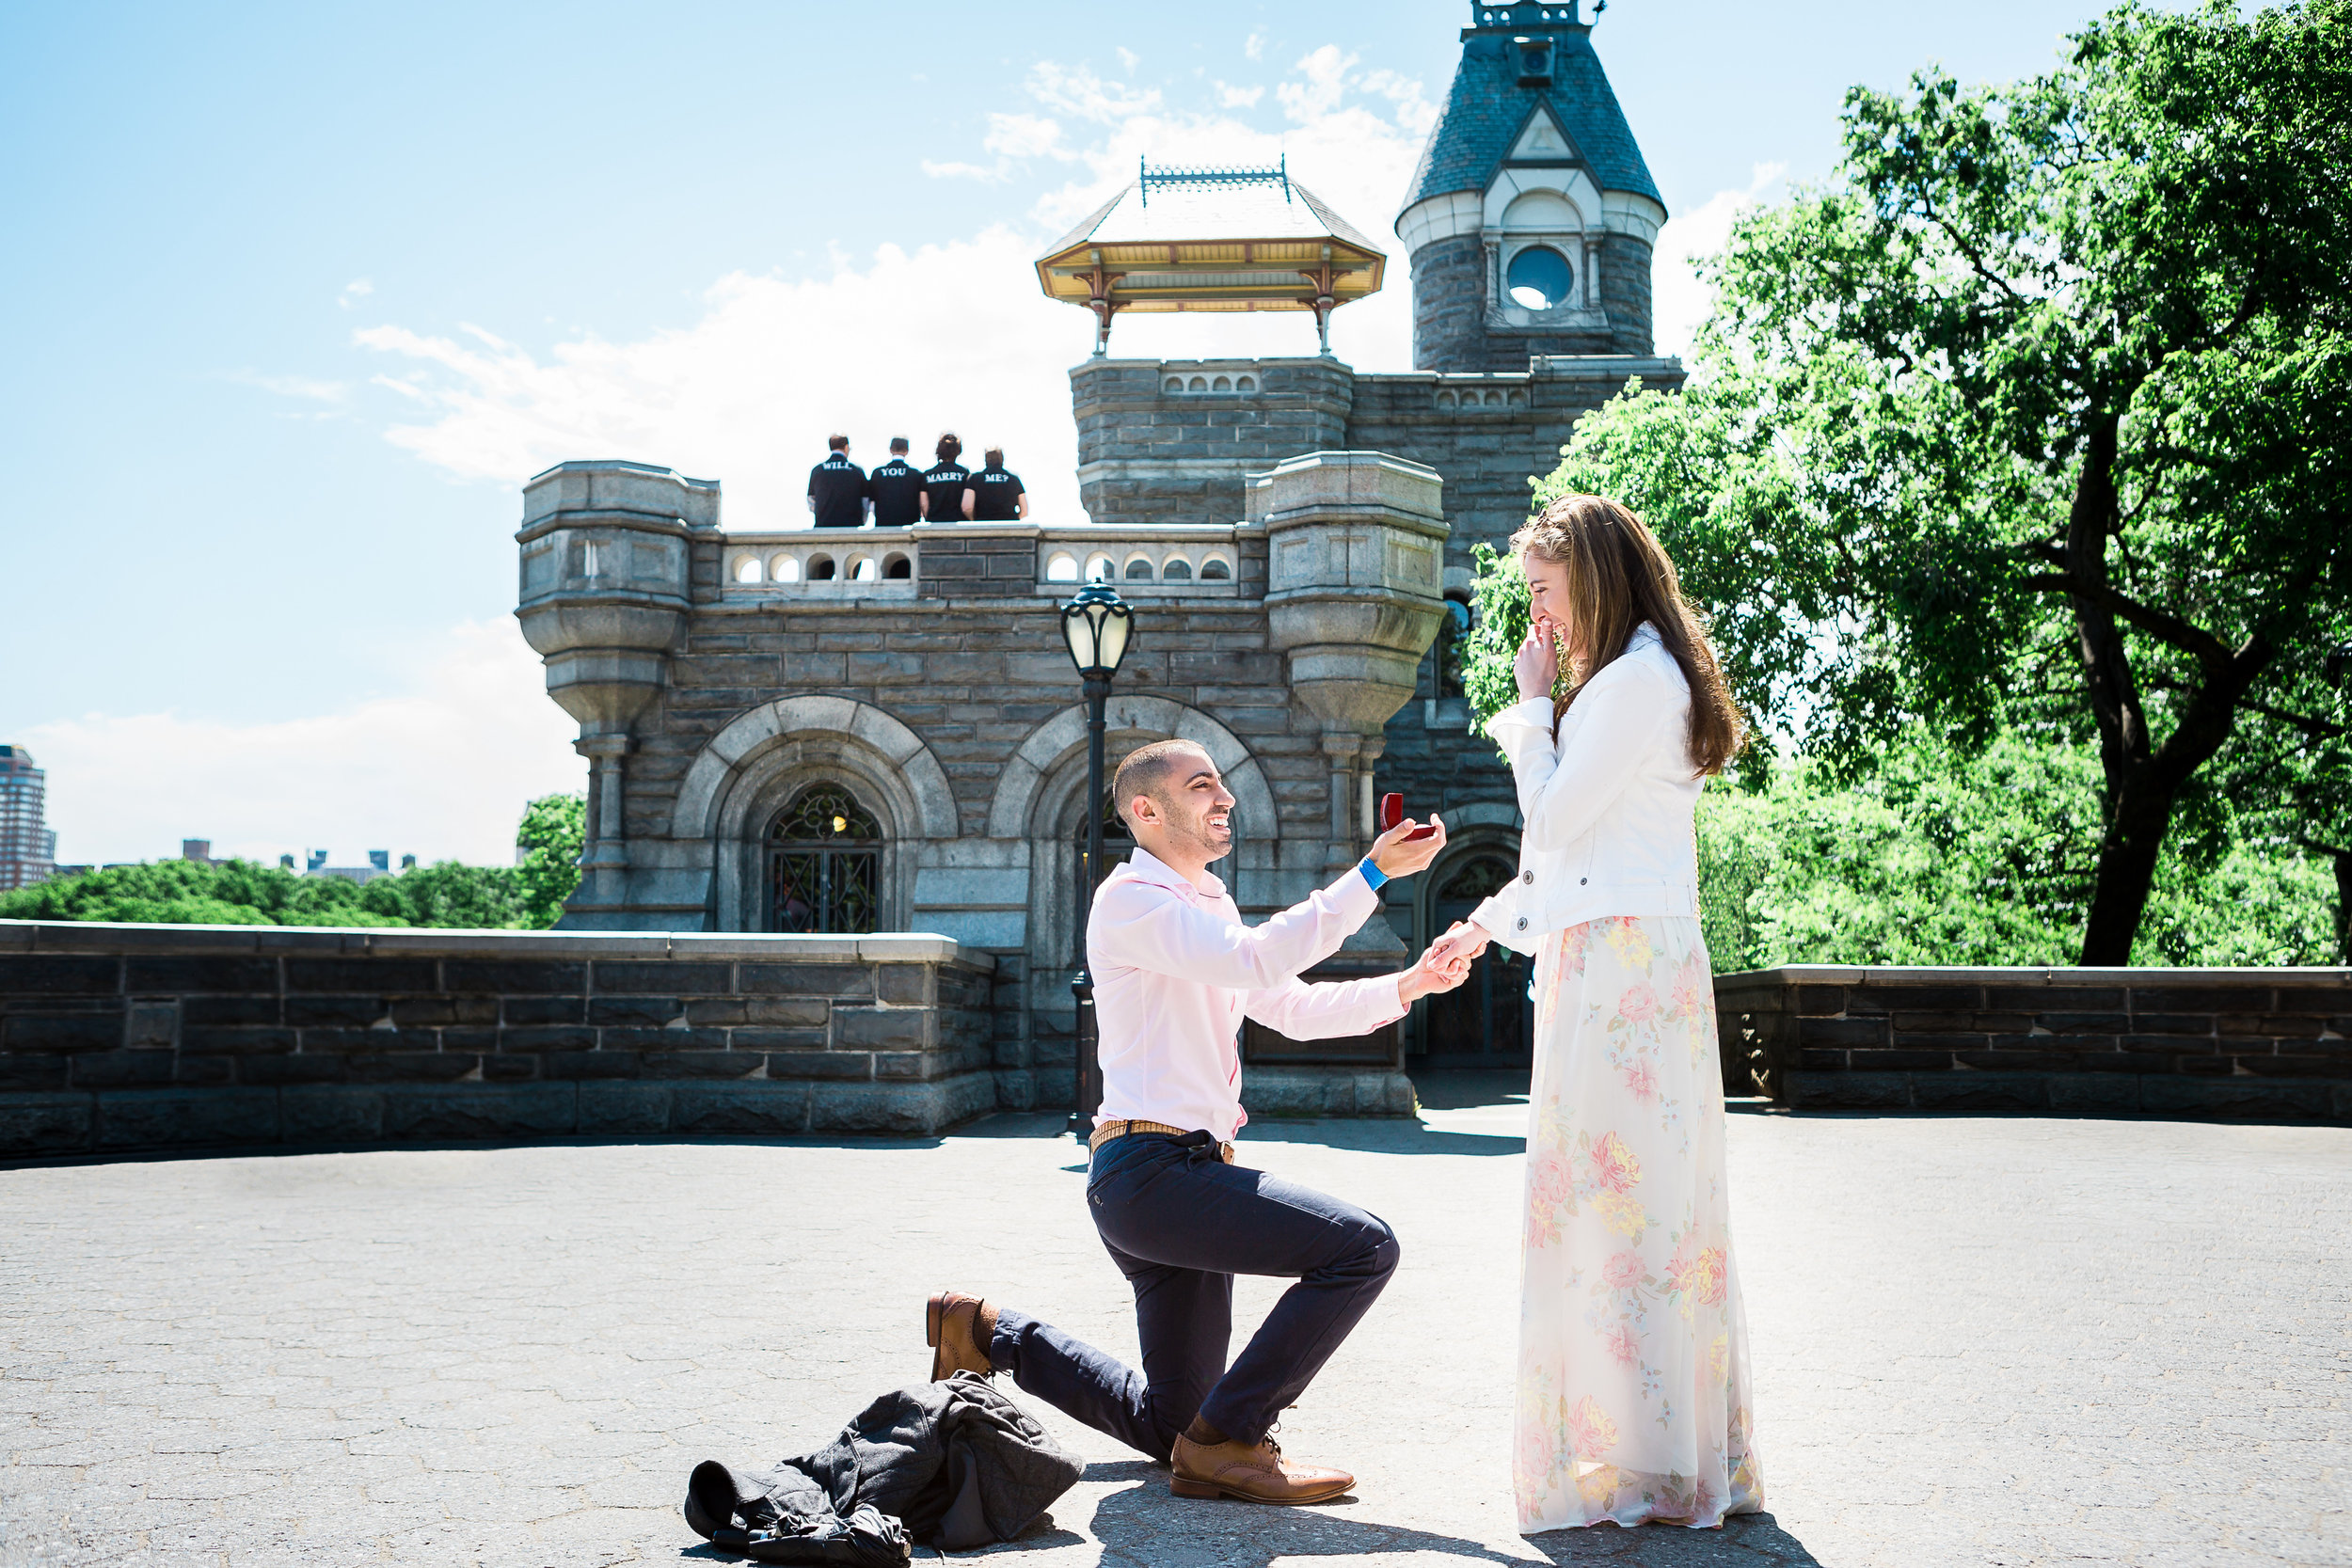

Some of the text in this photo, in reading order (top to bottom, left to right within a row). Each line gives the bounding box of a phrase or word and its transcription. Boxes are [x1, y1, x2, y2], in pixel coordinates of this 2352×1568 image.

[822, 461, 851, 470] WILL
[881, 467, 906, 476] YOU
[926, 472, 964, 483] MARRY
[985, 474, 1009, 483] ME?
